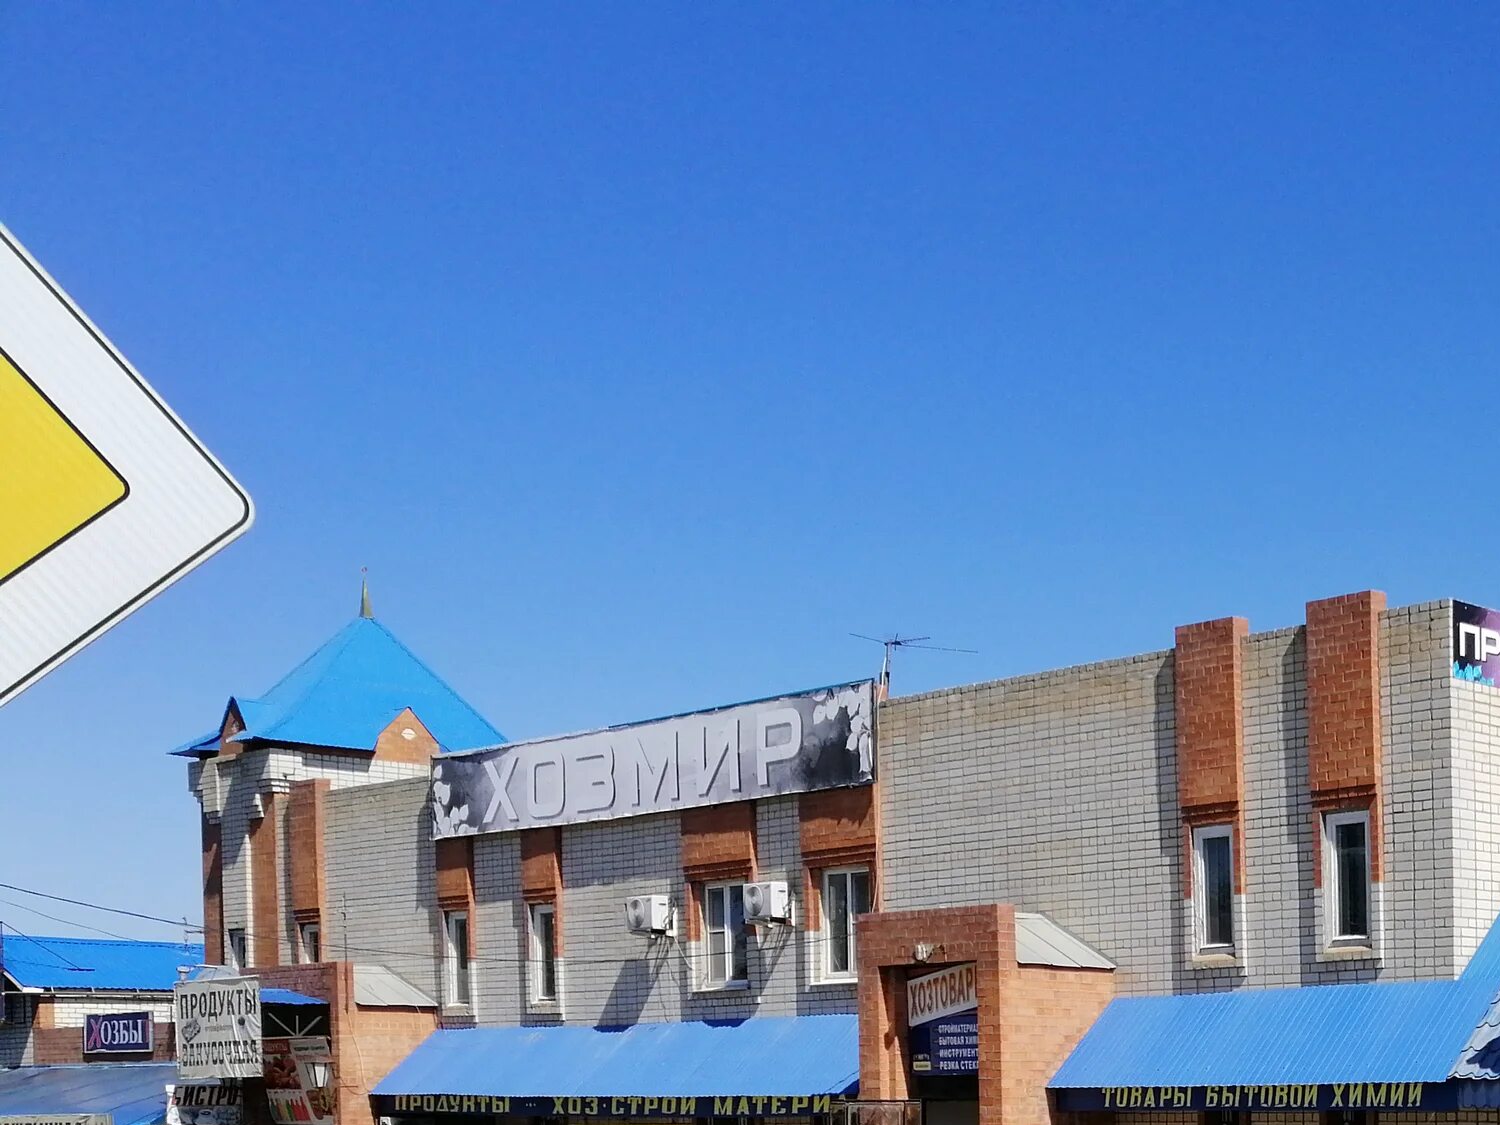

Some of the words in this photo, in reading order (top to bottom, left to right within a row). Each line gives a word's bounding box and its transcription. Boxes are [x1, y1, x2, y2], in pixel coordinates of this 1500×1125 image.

[481, 707, 804, 824] ХОЗМИР
[180, 988, 257, 1022] ПРОДУКТЫ
[182, 1039, 259, 1067] ЗАКУСОЧНАЯ
[939, 1060, 960, 1071] РЕЗКА
[175, 1085, 241, 1106] БИСТРО
[394, 1095, 510, 1113] ПРОДУКТЫ
[1101, 1086, 1193, 1108] ТОВАРЫ
